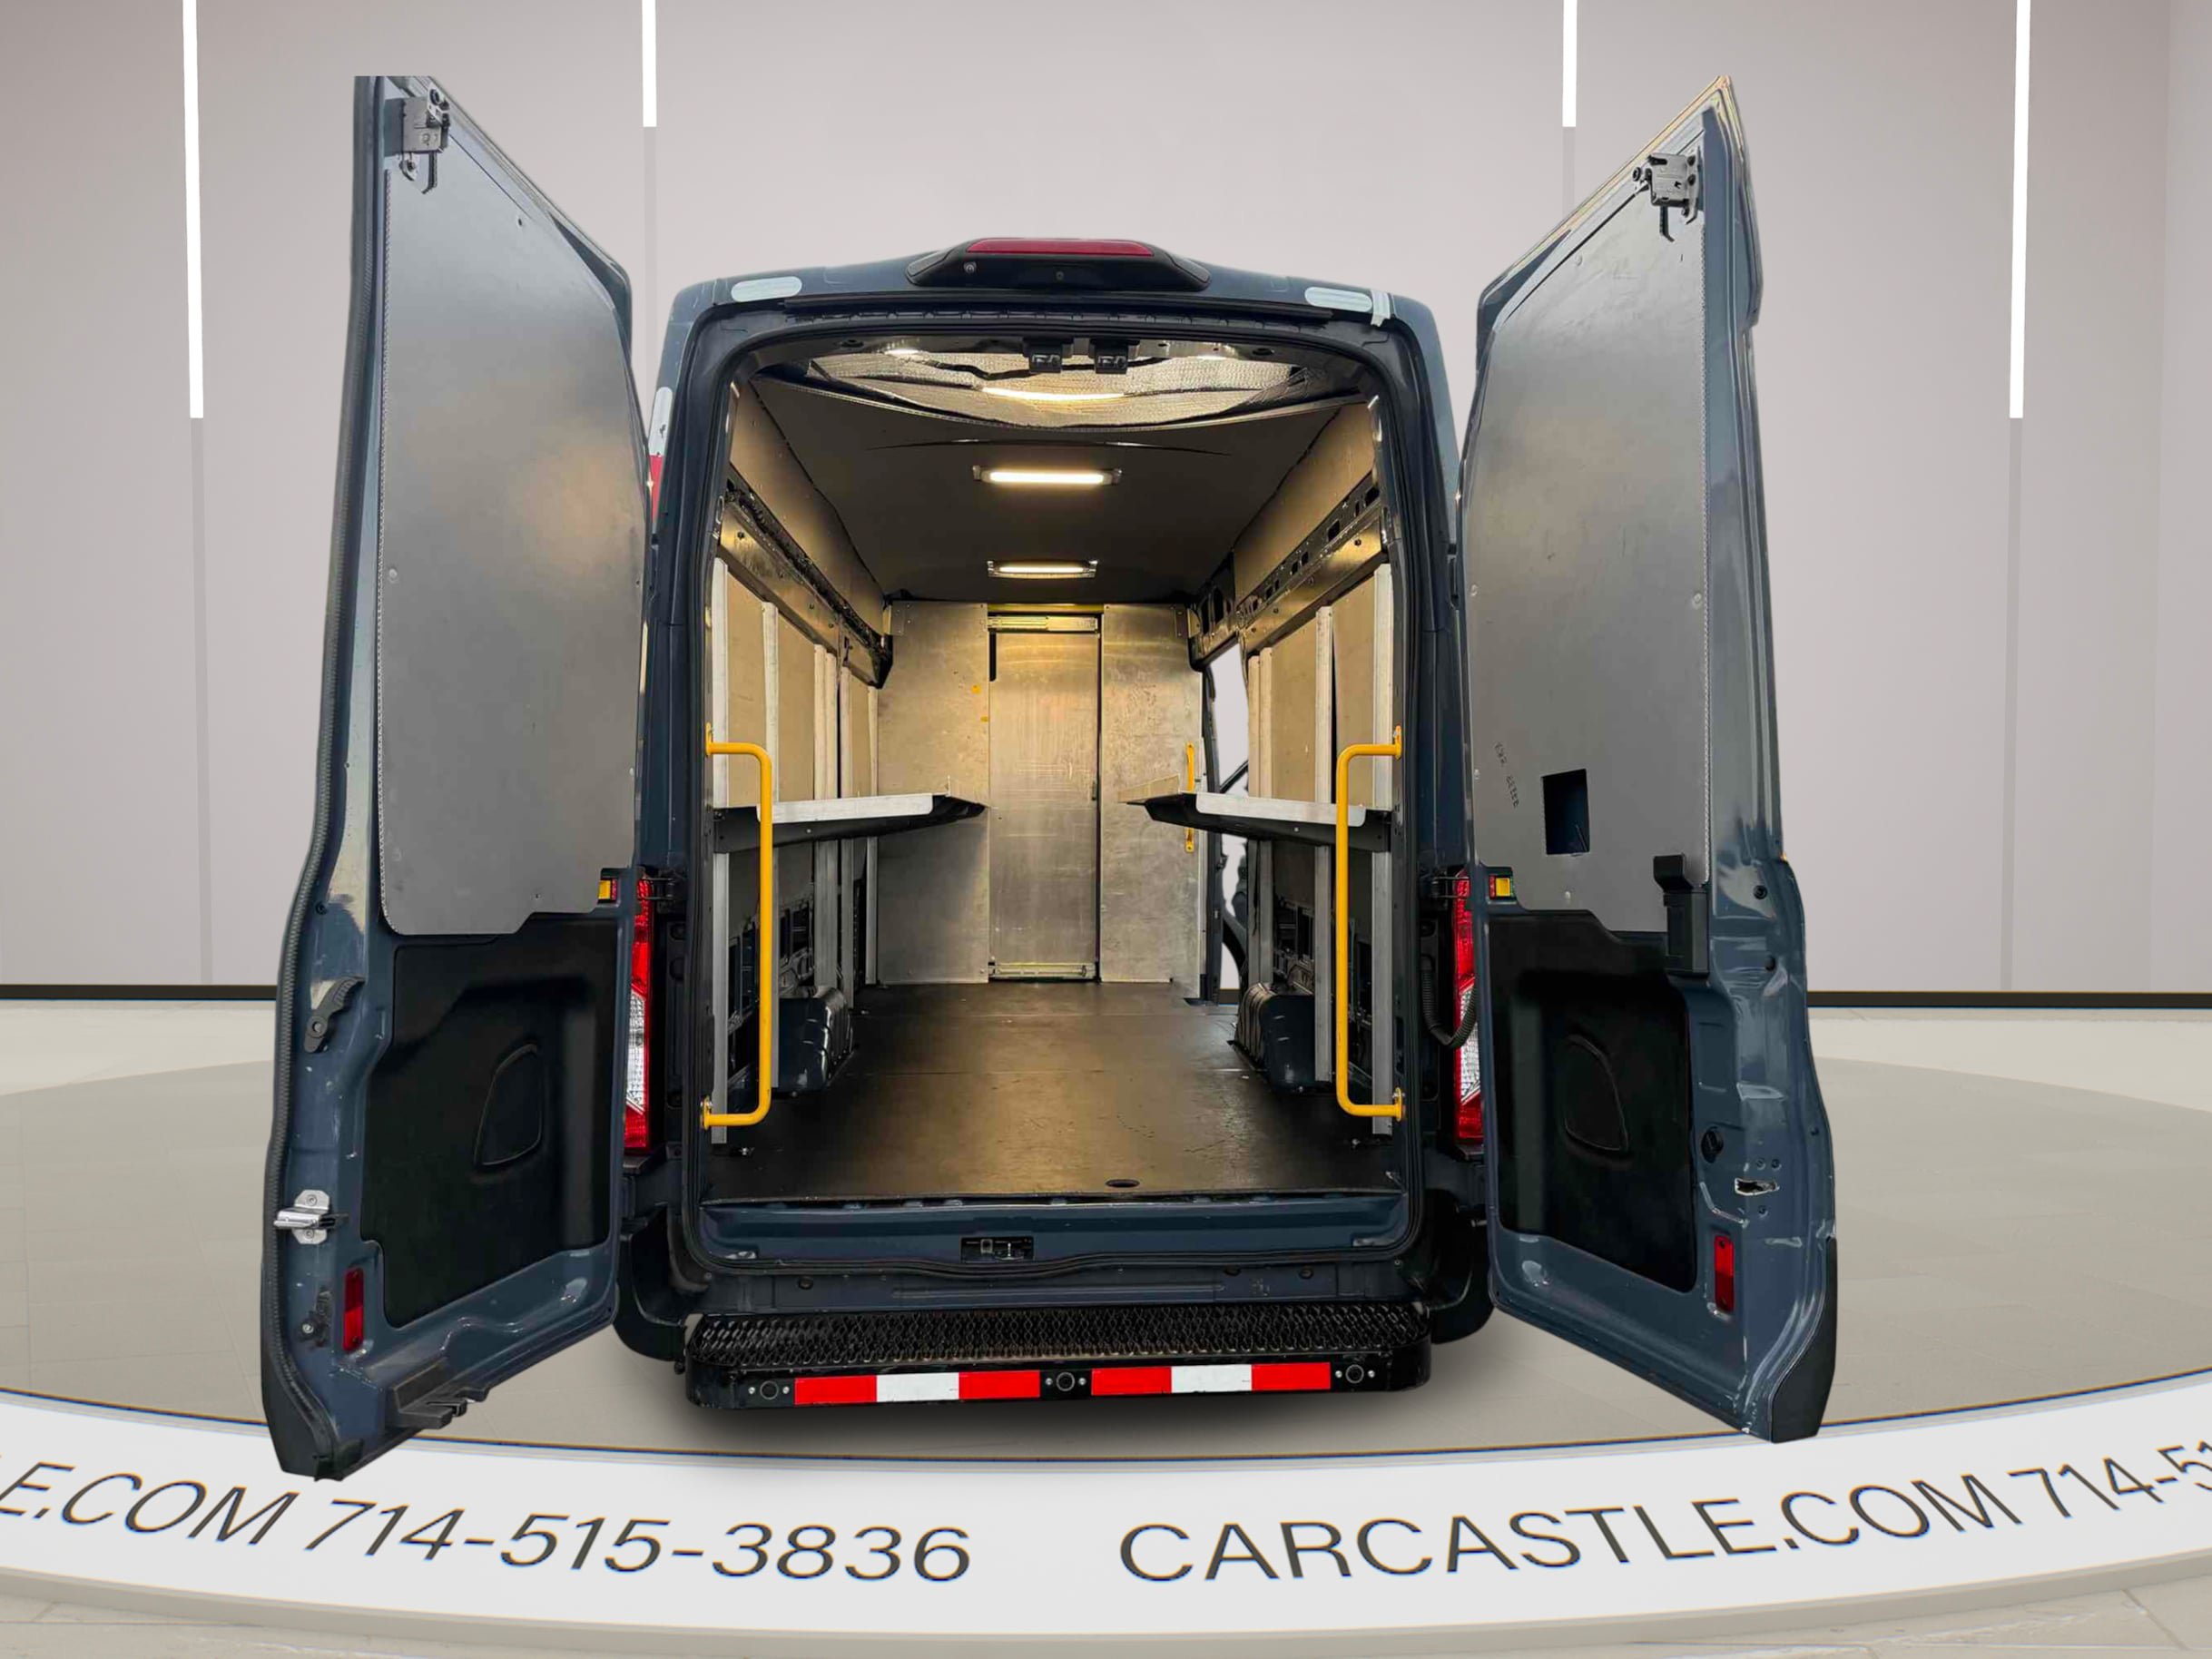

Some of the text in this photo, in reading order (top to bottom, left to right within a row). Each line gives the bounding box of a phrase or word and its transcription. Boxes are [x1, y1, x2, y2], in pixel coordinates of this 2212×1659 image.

[305, 1499, 970, 1582] 714-515-3836
[1120, 1440, 2212, 1582] CARCASTLE.COM 714-5
